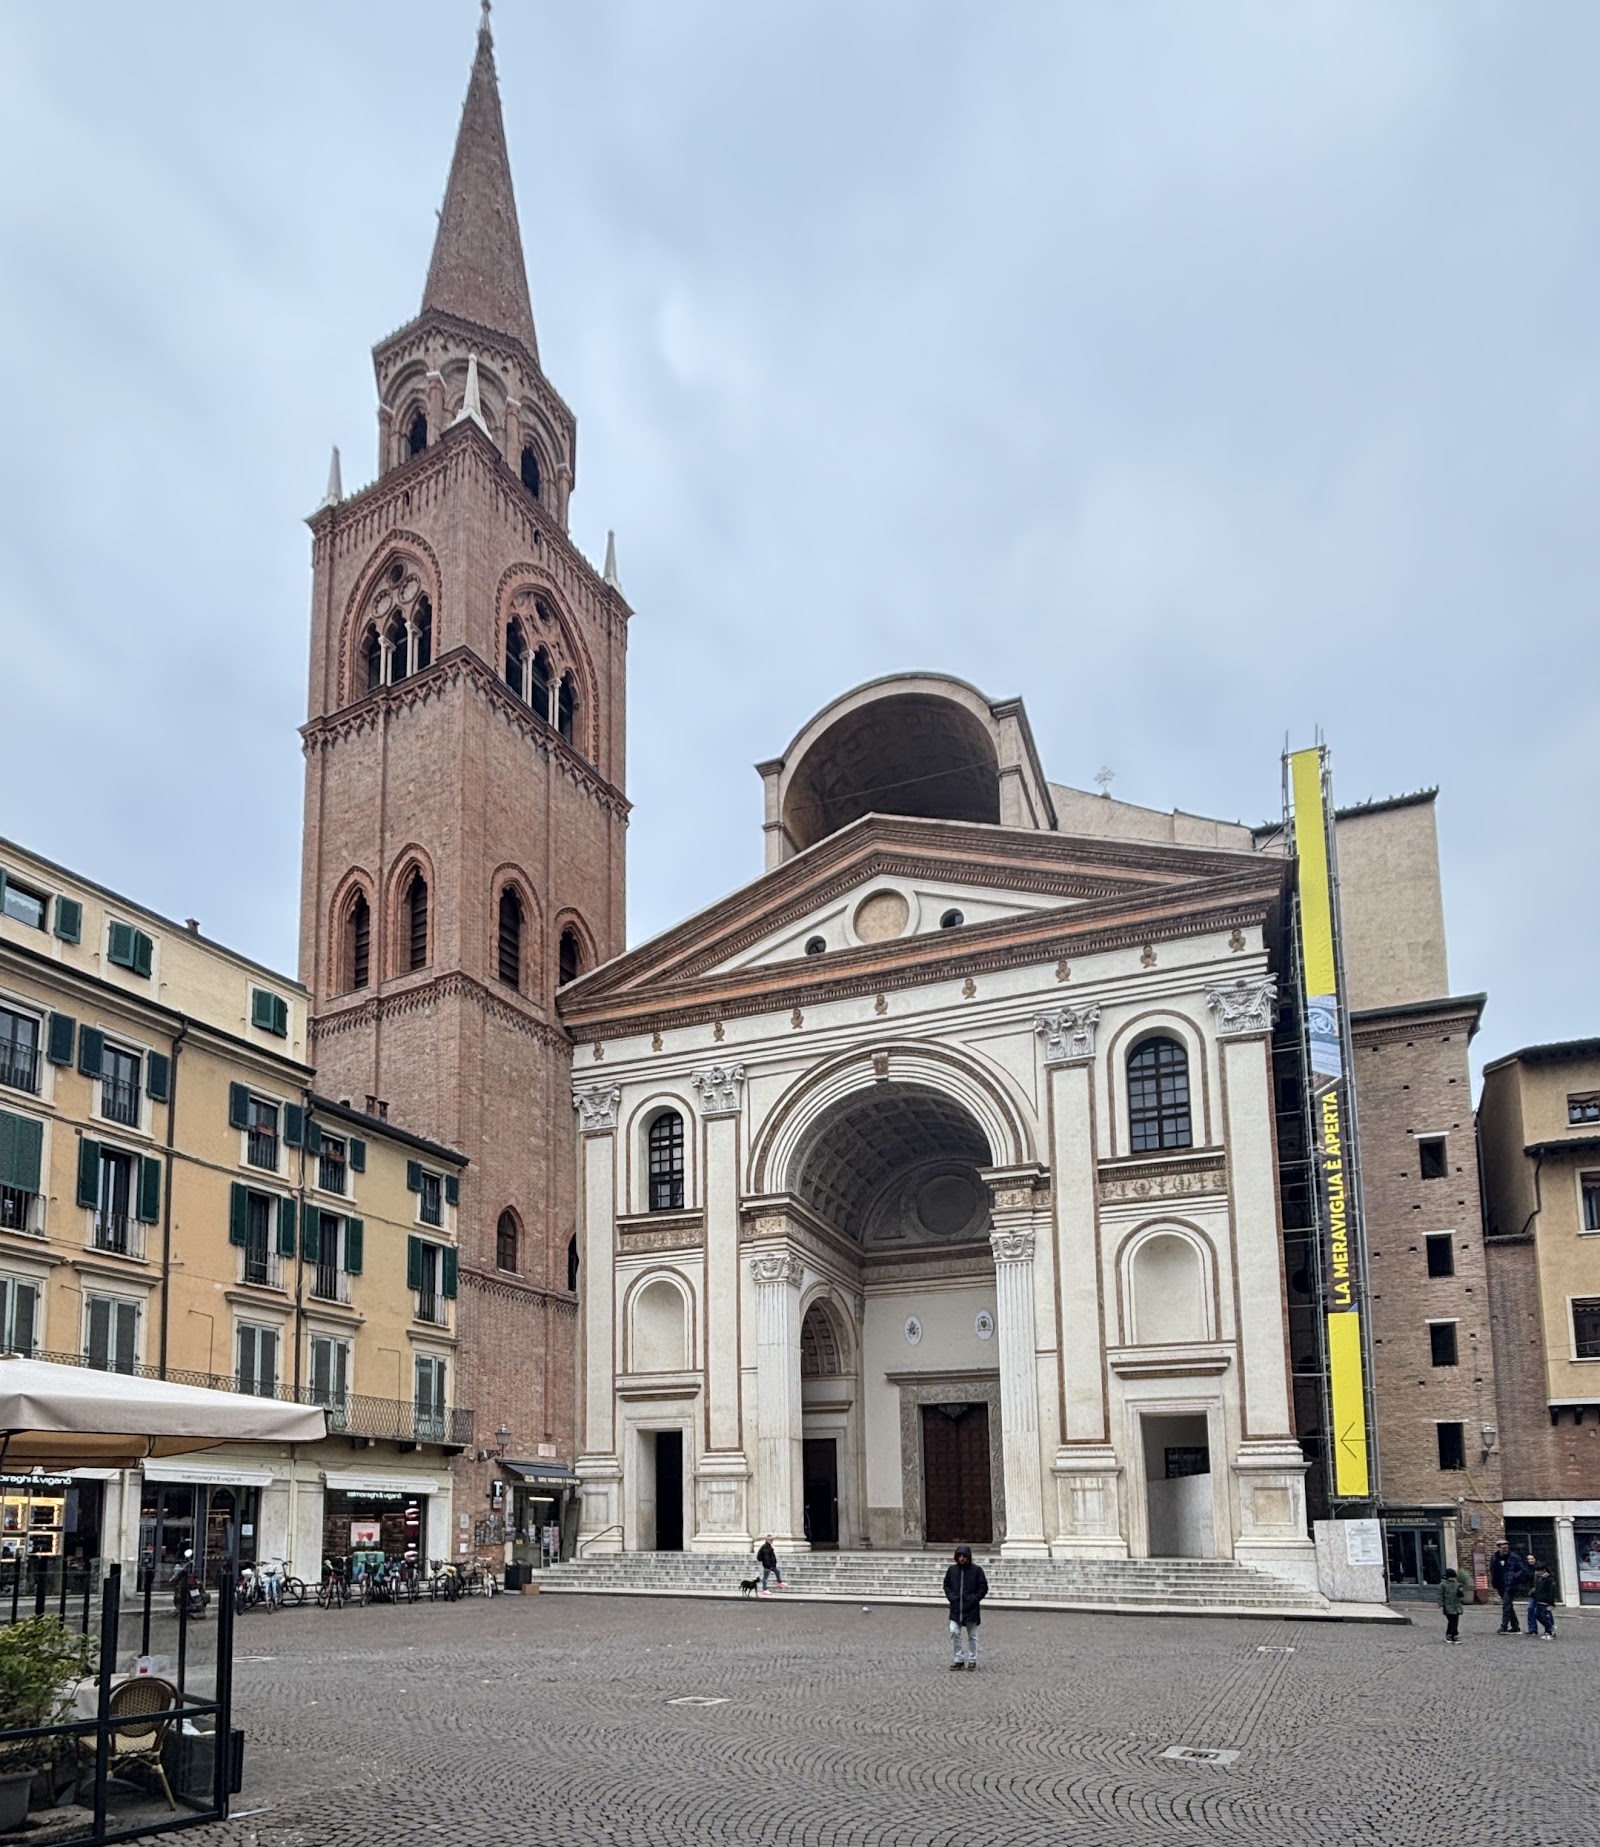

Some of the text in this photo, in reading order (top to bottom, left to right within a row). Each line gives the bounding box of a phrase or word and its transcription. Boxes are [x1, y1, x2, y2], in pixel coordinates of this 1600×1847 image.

[1322, 1091, 1351, 1304] LA MERAVIGLIA È APERTA
